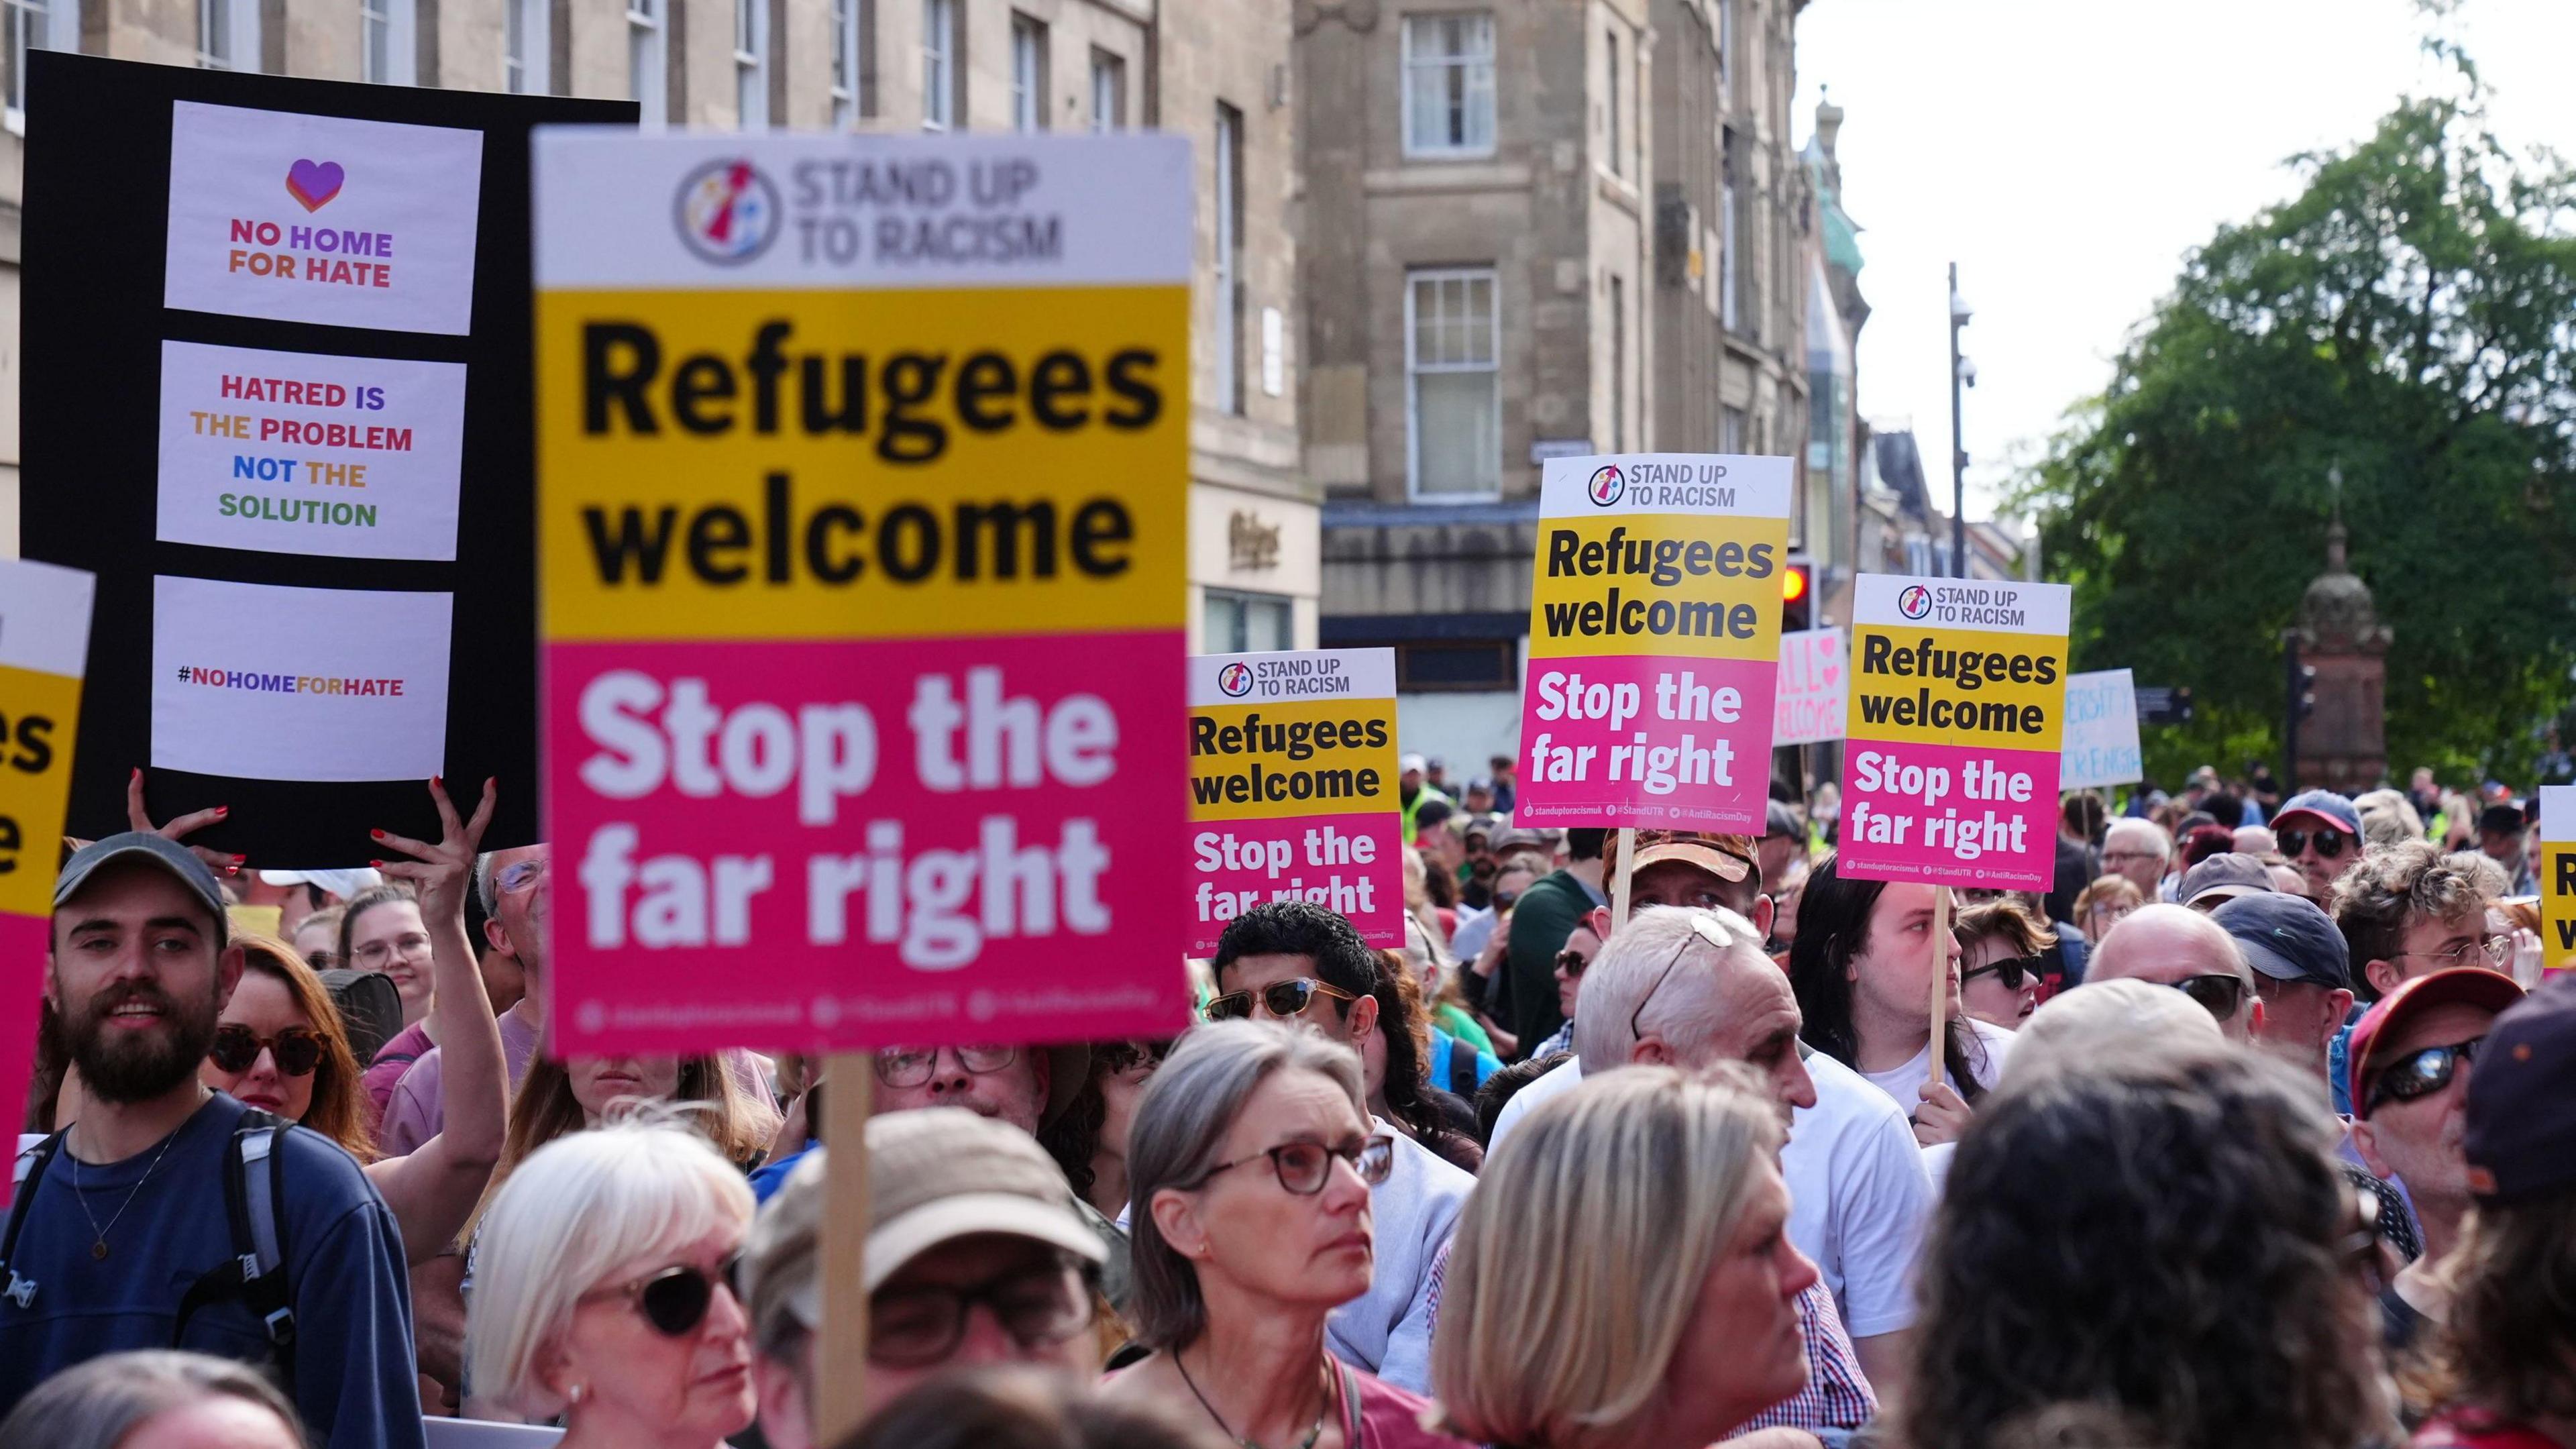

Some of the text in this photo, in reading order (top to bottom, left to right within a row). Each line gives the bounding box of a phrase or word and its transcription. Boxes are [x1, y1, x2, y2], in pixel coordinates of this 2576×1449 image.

[790, 157, 1040, 211] STAND UP
[230, 219, 392, 258] NO HOME
[793, 213, 1063, 266] TO RACISM
[229, 250, 390, 288] FOR HATE
[221, 375, 385, 411] HATRED IS
[579, 317, 1164, 466] Refugees
[190, 411, 412, 451] THE PROBLEM
[233, 455, 367, 488] NOT THE
[1630, 464, 1727, 484] STAND UP
[219, 494, 377, 527] SOLUTION
[1629, 486, 1735, 508] TO RACISM
[580, 471, 1134, 586] welcome
[1548, 527, 1774, 586] Refugees
[1544, 587, 1757, 639] welcome
[1935, 605, 2025, 627] TO RACISM
[1936, 587, 2017, 608] STAND UP
[178, 665, 404, 696] #NOHOMEFORHATE
[1257, 659, 1340, 679] STAND UP
[1862, 634, 2056, 690] Refugees
[1258, 676, 1350, 696] TO RACISM
[1536, 671, 1741, 731] Stop the
[1860, 688, 2044, 735] welcome
[578, 665, 1119, 826] Stop the
[1189, 714, 1388, 761] Refugees
[1191, 763, 1380, 805] welcome
[1532, 732, 1734, 795] far right
[1854, 751, 2033, 806] Stop the
[1534, 806, 1602, 817] standuptoracismuk
[1851, 802, 2027, 859] far right
[1193, 826, 1376, 879] Stop the
[1857, 862, 1919, 873] standuptoracismuk
[578, 812, 1111, 972] far right
[1195, 881, 1258, 922] far
